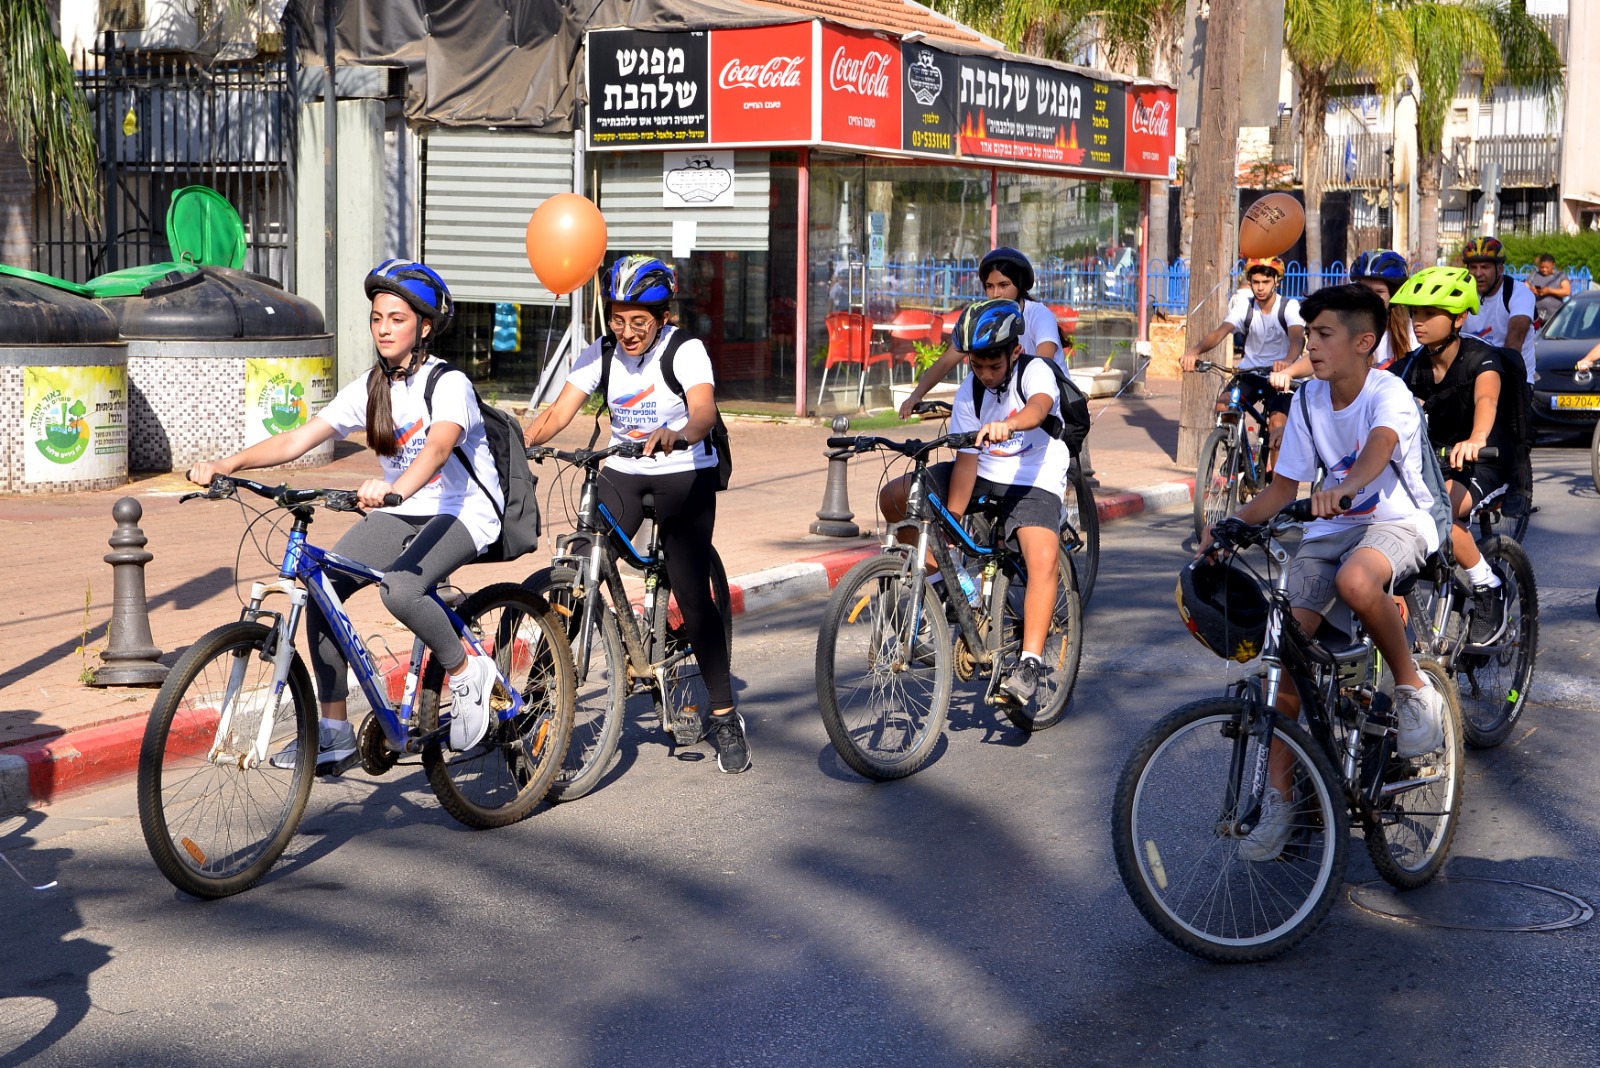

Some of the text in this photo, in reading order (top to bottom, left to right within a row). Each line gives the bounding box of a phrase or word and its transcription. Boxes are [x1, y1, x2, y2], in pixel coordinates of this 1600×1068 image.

[616, 47, 685, 77] מפגש
[718, 56, 805, 90] Coca-Cola
[830, 46, 892, 98] Coca-Cola
[604, 75, 698, 111] שלהבת
[960, 63, 1082, 119] מפגש שלהבת
[639, 117, 652, 127] אש
[1132, 96, 1171, 137] Coca-Cola
[30, 389, 62, 428] באור יהודה
[641, 401, 657, 409] מסע
